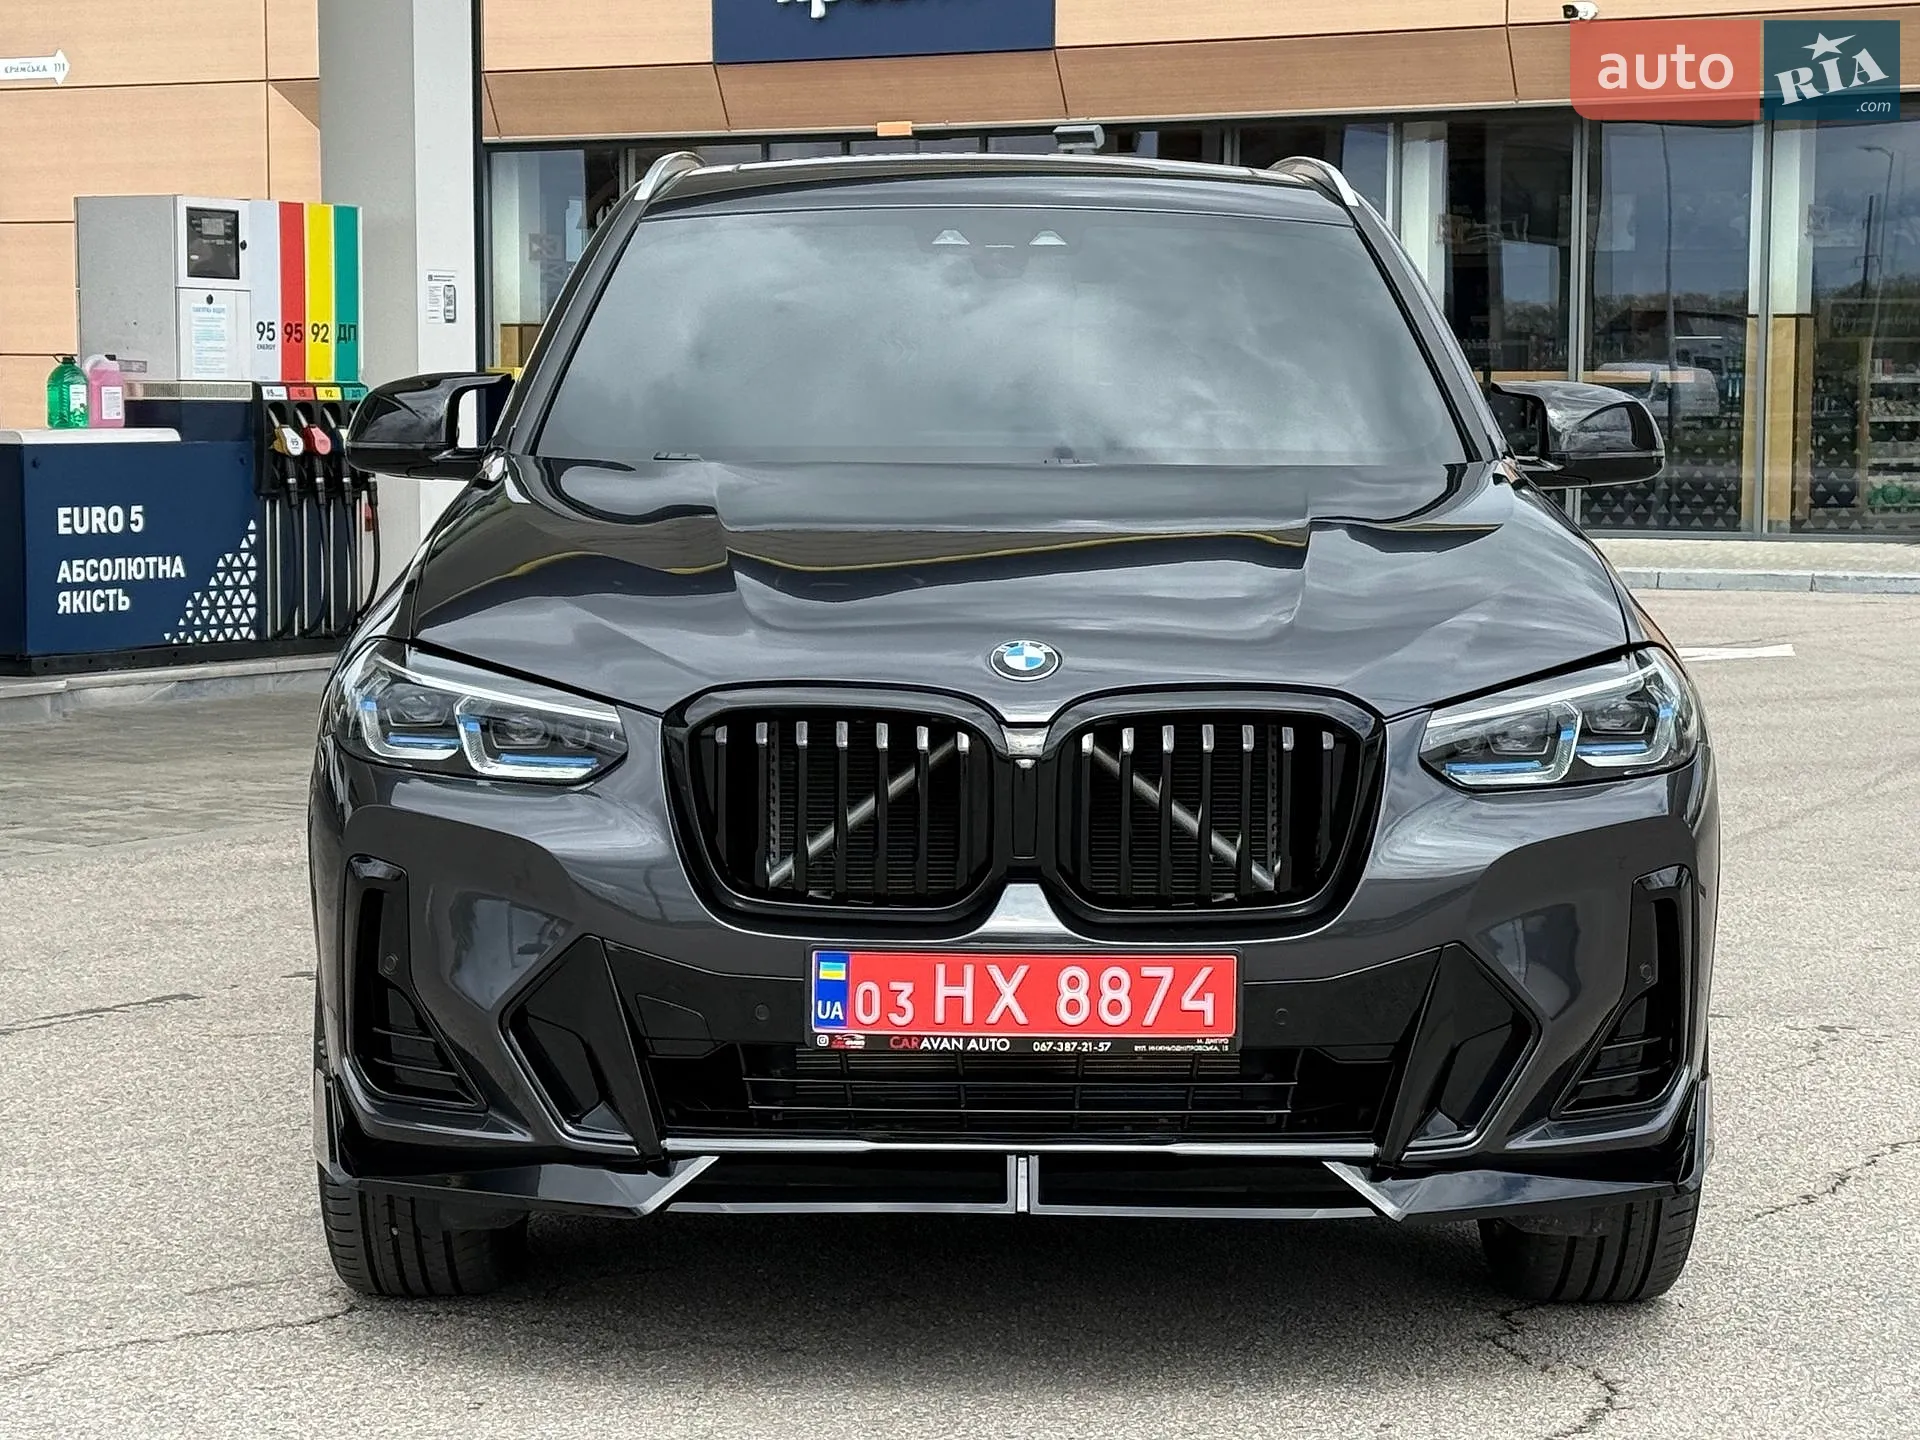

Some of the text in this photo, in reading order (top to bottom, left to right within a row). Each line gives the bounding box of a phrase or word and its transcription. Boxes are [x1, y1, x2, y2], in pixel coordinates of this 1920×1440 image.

[4, 64, 48, 74] КРИМСЬКА
[256, 321, 276, 342] 95
[284, 322, 304, 344] 95
[311, 322, 330, 344] 92
[337, 323, 357, 344] ДП
[324, 389, 333, 398] 92
[57, 505, 144, 535] EURO 5
[57, 555, 186, 583] АБСОЛЮТНА
[57, 588, 130, 615] ЯКІСТЬ
[855, 963, 1216, 1027] 03 HX 8874
[817, 1001, 844, 1021] UA
[889, 1036, 1010, 1052] CARAVAN AUTO
[1033, 1041, 1112, 1052] 067-387-21-57
